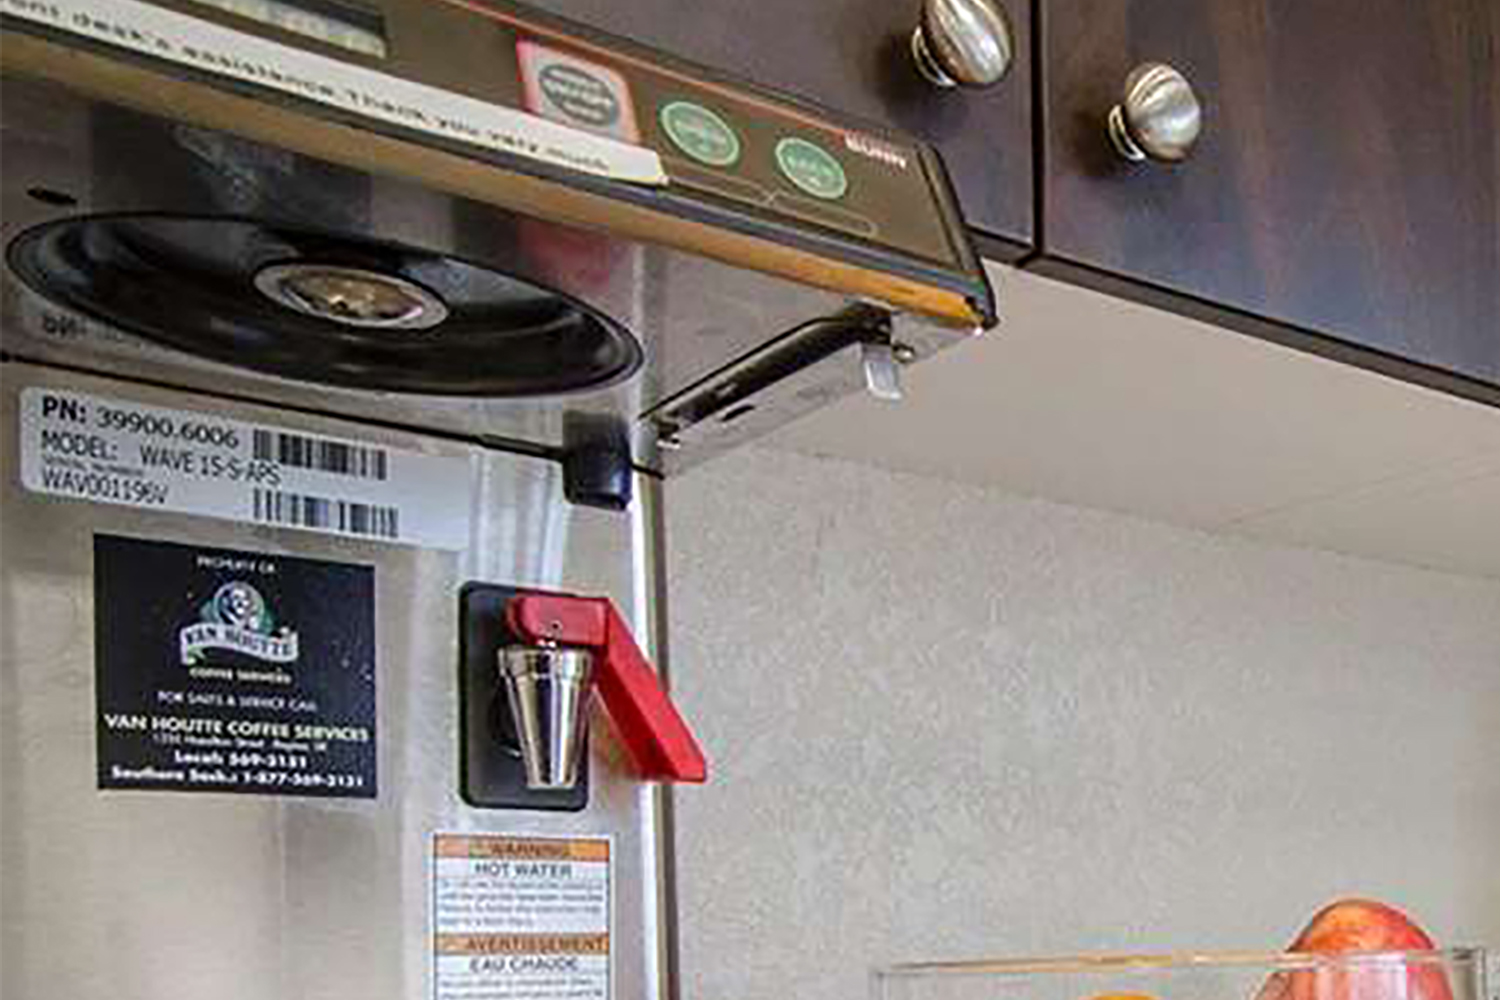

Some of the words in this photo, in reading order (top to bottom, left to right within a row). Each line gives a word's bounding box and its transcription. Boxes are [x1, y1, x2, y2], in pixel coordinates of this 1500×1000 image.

[42, 395, 87, 424] PN:
[96, 406, 240, 450] 39900.6006
[42, 429, 118, 461] MODEL:
[139, 444, 194, 474] WAVE
[104, 713, 148, 731] VAN
[151, 716, 224, 736] HOUTTE
[227, 720, 291, 739] COFFEE
[294, 724, 370, 744] SERVICES
[475, 862, 509, 877] HOT
[515, 862, 574, 879] WATER
[469, 957, 505, 973] EAU
